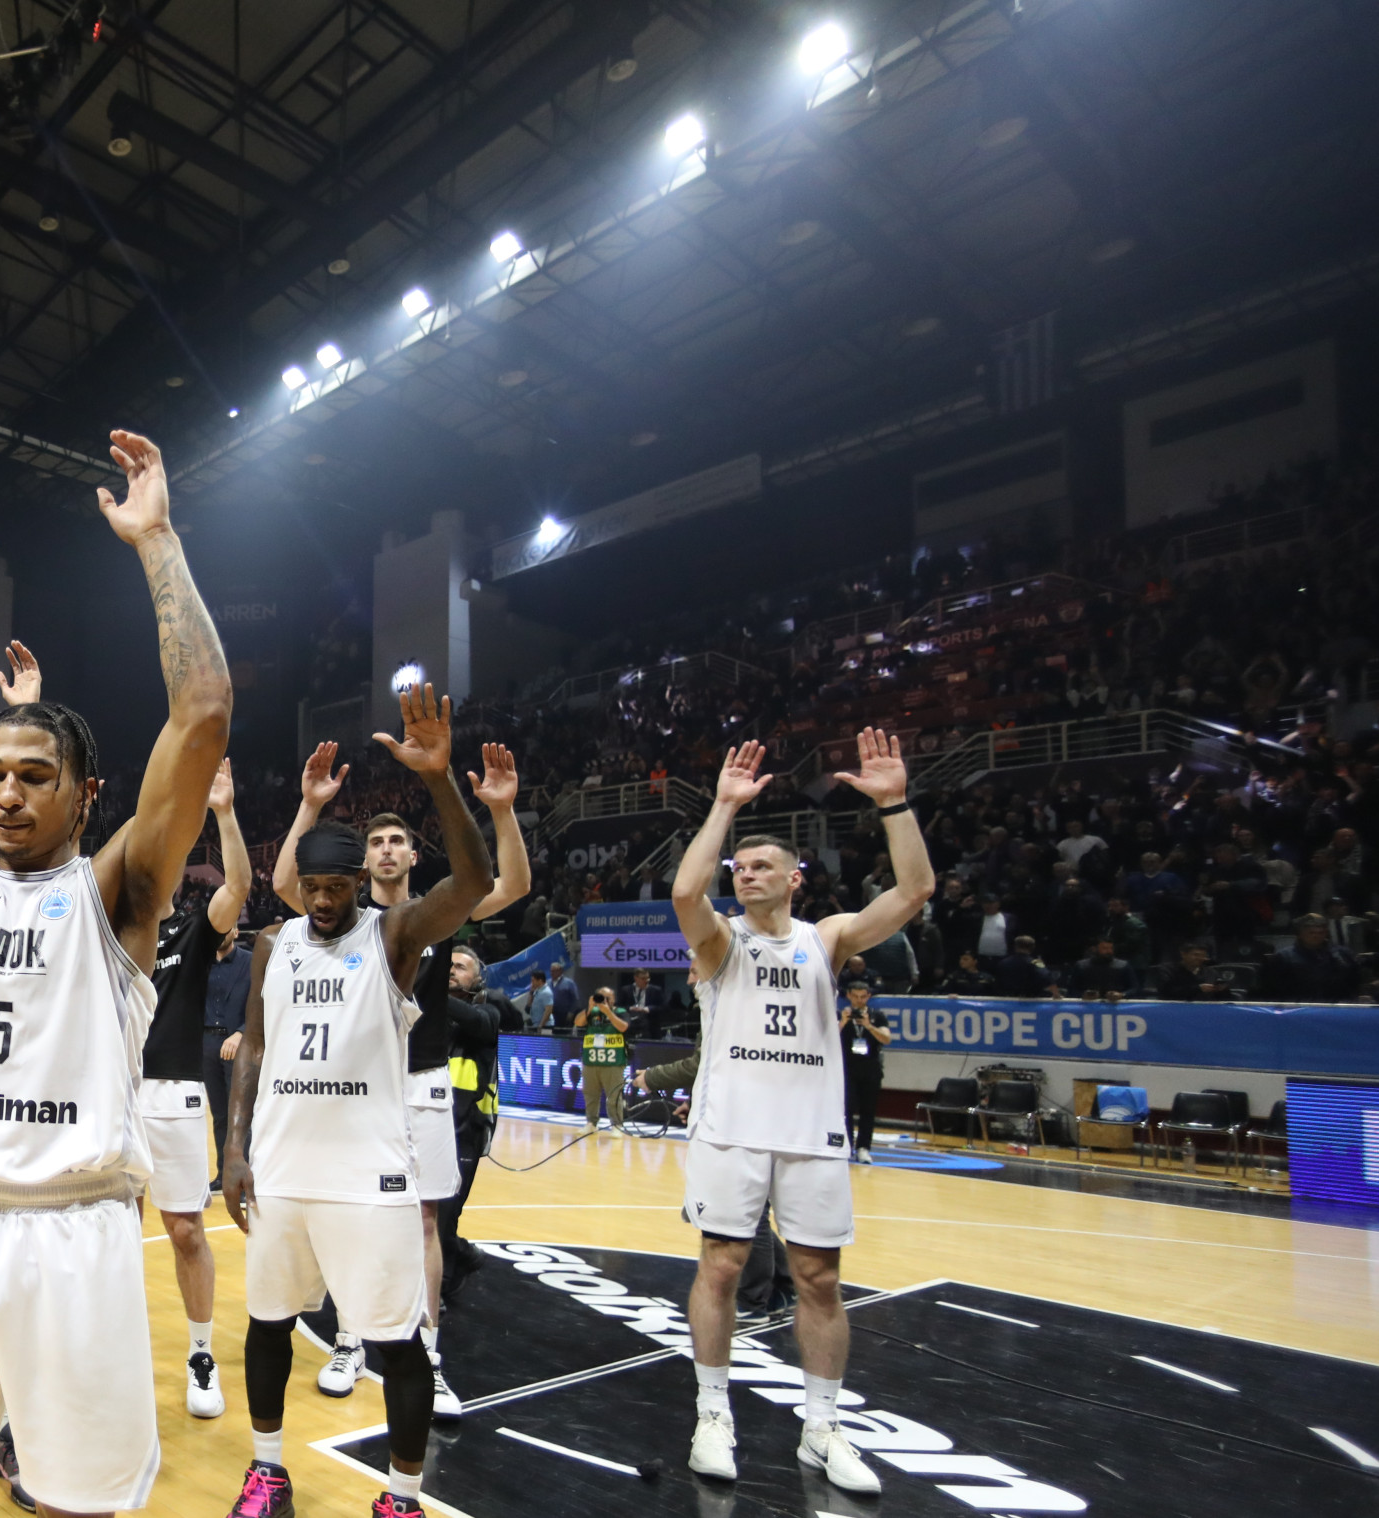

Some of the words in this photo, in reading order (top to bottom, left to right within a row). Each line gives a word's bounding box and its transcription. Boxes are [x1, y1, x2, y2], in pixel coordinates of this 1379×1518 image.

[987, 613, 1050, 637] AENA
[586, 915, 607, 927] FIBA
[609, 914, 645, 926] EUROPE
[647, 913, 667, 926] CUP
[756, 966, 801, 989] PAOK
[293, 977, 345, 1004] PAOK
[764, 1003, 797, 1037] 33
[881, 1008, 1038, 1047] EUROPE
[1051, 1011, 1148, 1051] CUP
[299, 1022, 330, 1061] 21
[588, 1048, 616, 1063] 352
[729, 1045, 824, 1067] Stoiximan
[273, 1077, 368, 1096] Stoiximan
